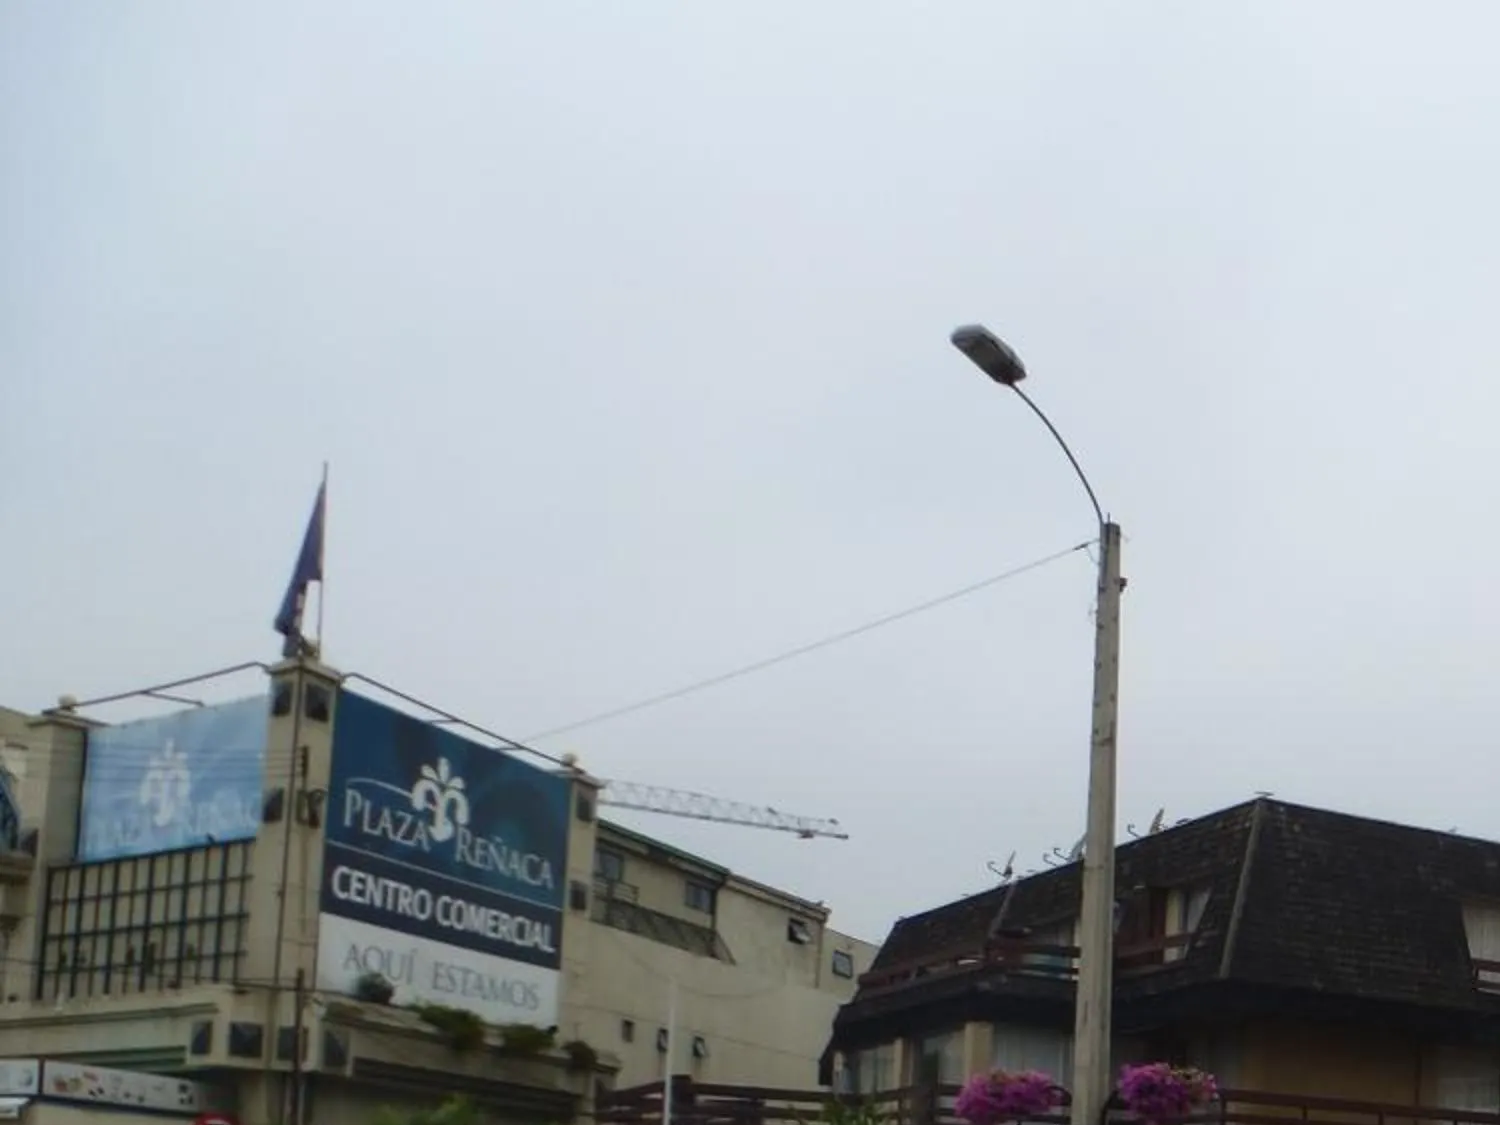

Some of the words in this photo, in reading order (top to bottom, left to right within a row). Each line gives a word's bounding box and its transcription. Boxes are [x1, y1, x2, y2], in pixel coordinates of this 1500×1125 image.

[343, 788, 431, 853] PLAZA
[455, 823, 554, 889] REÑACA
[332, 865, 432, 921] CENTRO
[435, 896, 555, 953] COMERCIAL
[343, 943, 418, 986] AQUÍ
[432, 961, 539, 1011] ESTAMOS
